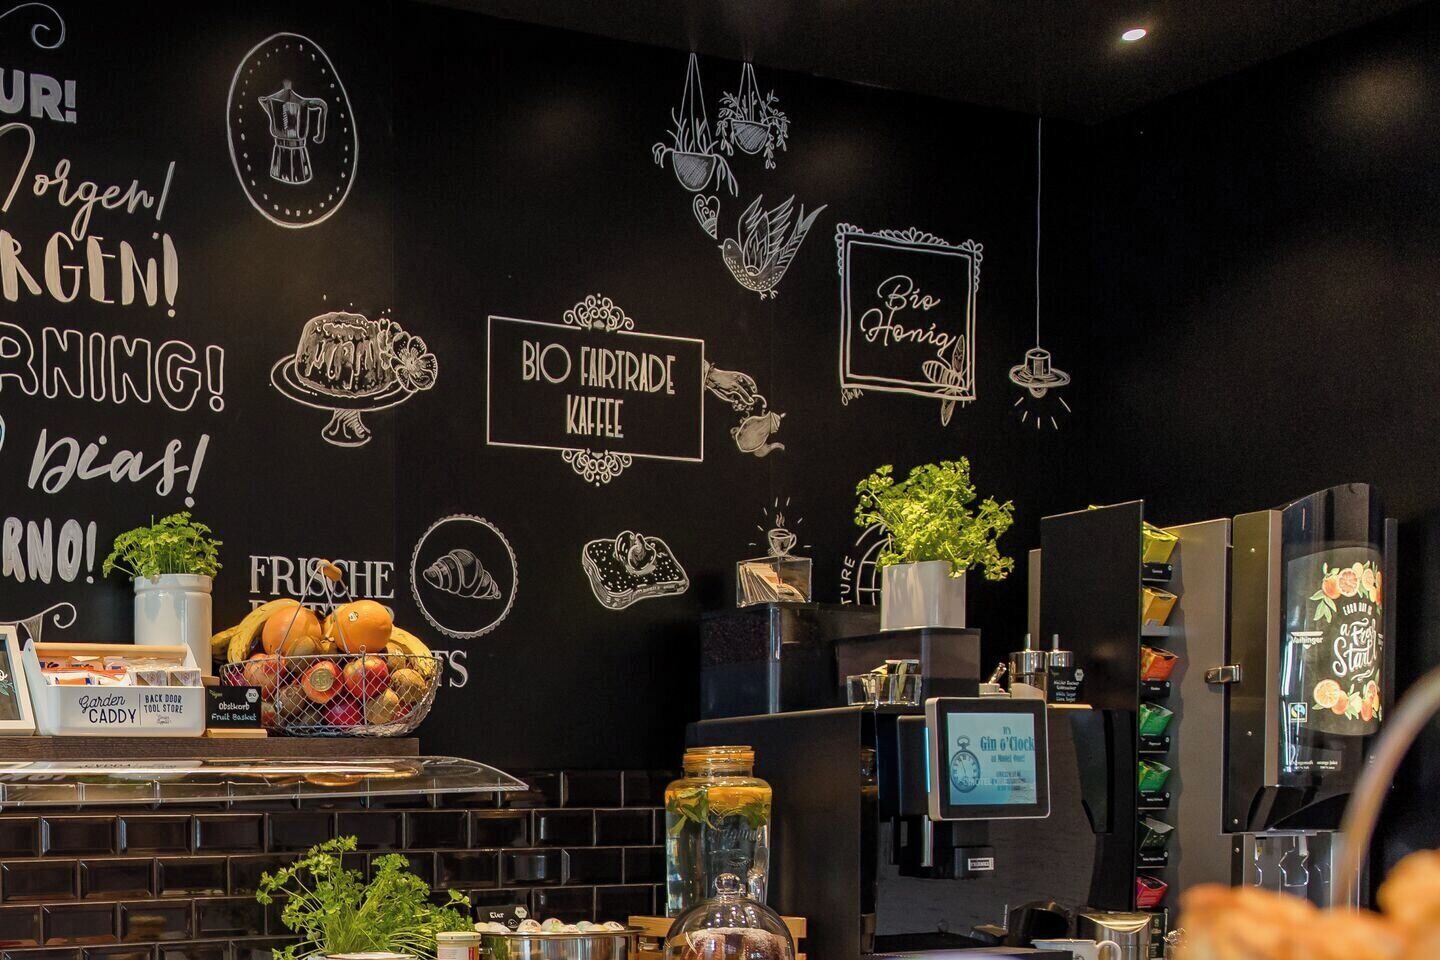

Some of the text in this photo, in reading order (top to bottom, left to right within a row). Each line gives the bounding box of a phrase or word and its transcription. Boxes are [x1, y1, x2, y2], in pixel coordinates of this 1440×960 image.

[877, 275, 941, 311] Bio
[860, 306, 957, 371] Honig
[523, 340, 676, 395] BIO FAIRTRADE
[566, 394, 624, 439] KAFFEE
[249, 555, 394, 599] FRISCHE
[1340, 624, 1350, 636] a
[79, 692, 126, 714] Garden
[144, 704, 183, 713] TOOL STORE
[145, 694, 182, 703] BACK DOOR
[89, 708, 136, 723] CADDY
[980, 736, 1034, 752] Gin o'Clock
